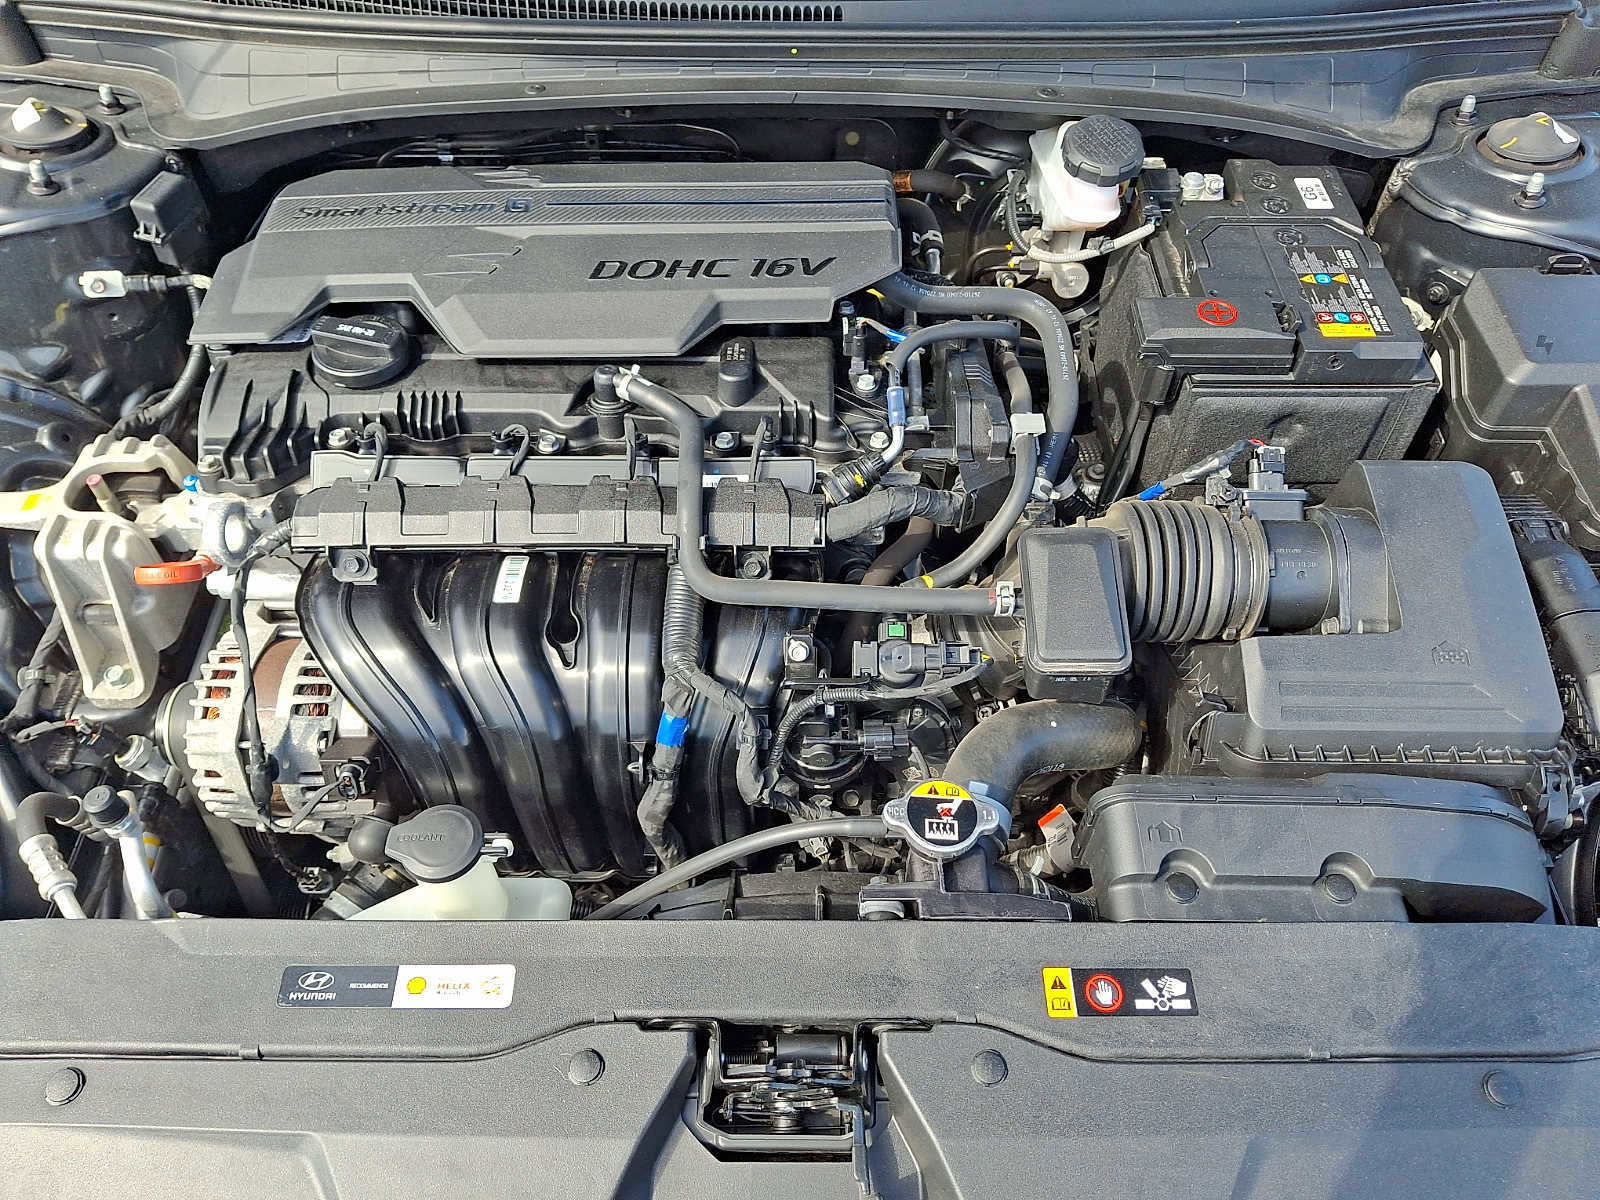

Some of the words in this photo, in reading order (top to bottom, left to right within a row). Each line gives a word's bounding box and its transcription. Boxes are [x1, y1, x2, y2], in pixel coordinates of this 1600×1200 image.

[292, 202, 498, 220] Smartstream
[588, 258, 740, 280] DOHC
[750, 256, 838, 278] 16V
[982, 809, 996, 821] 1.1
[397, 831, 446, 842] COOLANT
[288, 991, 337, 1001] HYUNDAI
